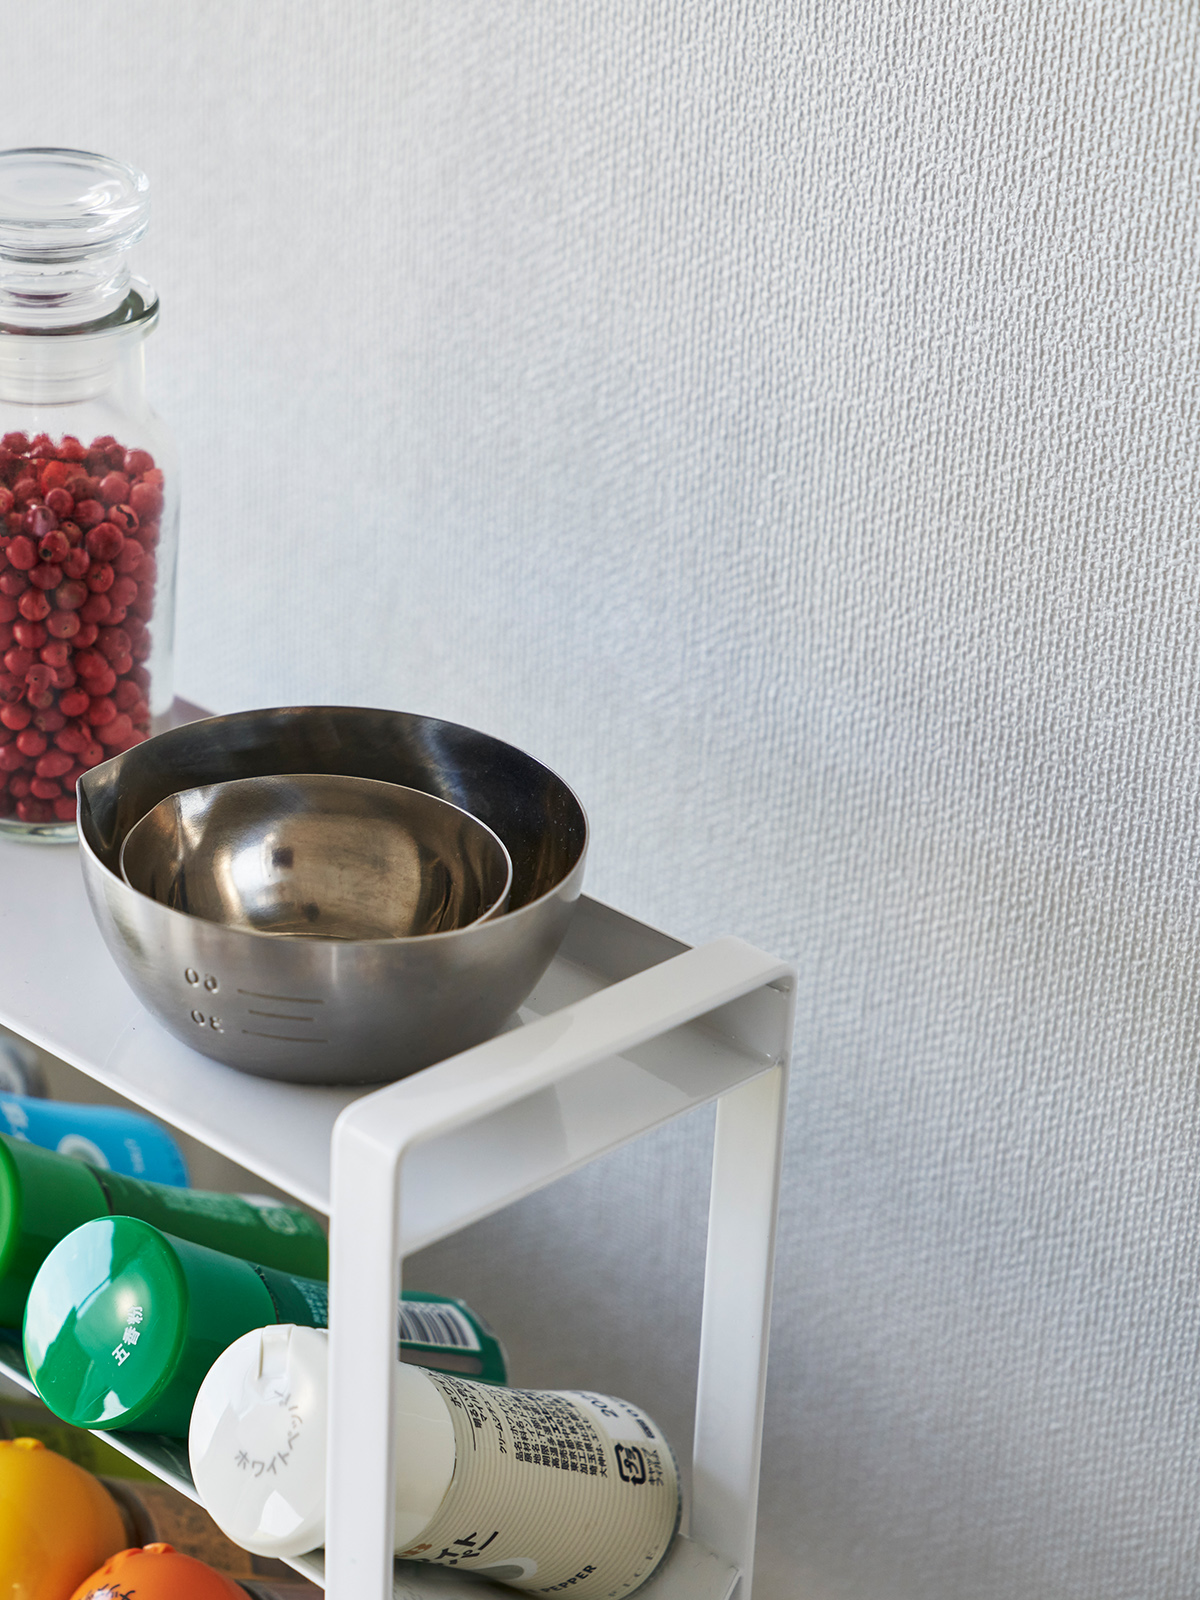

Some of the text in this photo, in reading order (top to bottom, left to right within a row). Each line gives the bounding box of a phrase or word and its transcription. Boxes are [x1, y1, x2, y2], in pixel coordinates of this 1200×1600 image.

[111, 1305, 143, 1367] 五香粉
[234, 1389, 304, 1478] ホワイトペッパー
[622, 1447, 640, 1475] プラ
[540, 1564, 598, 1593] PEPPER
